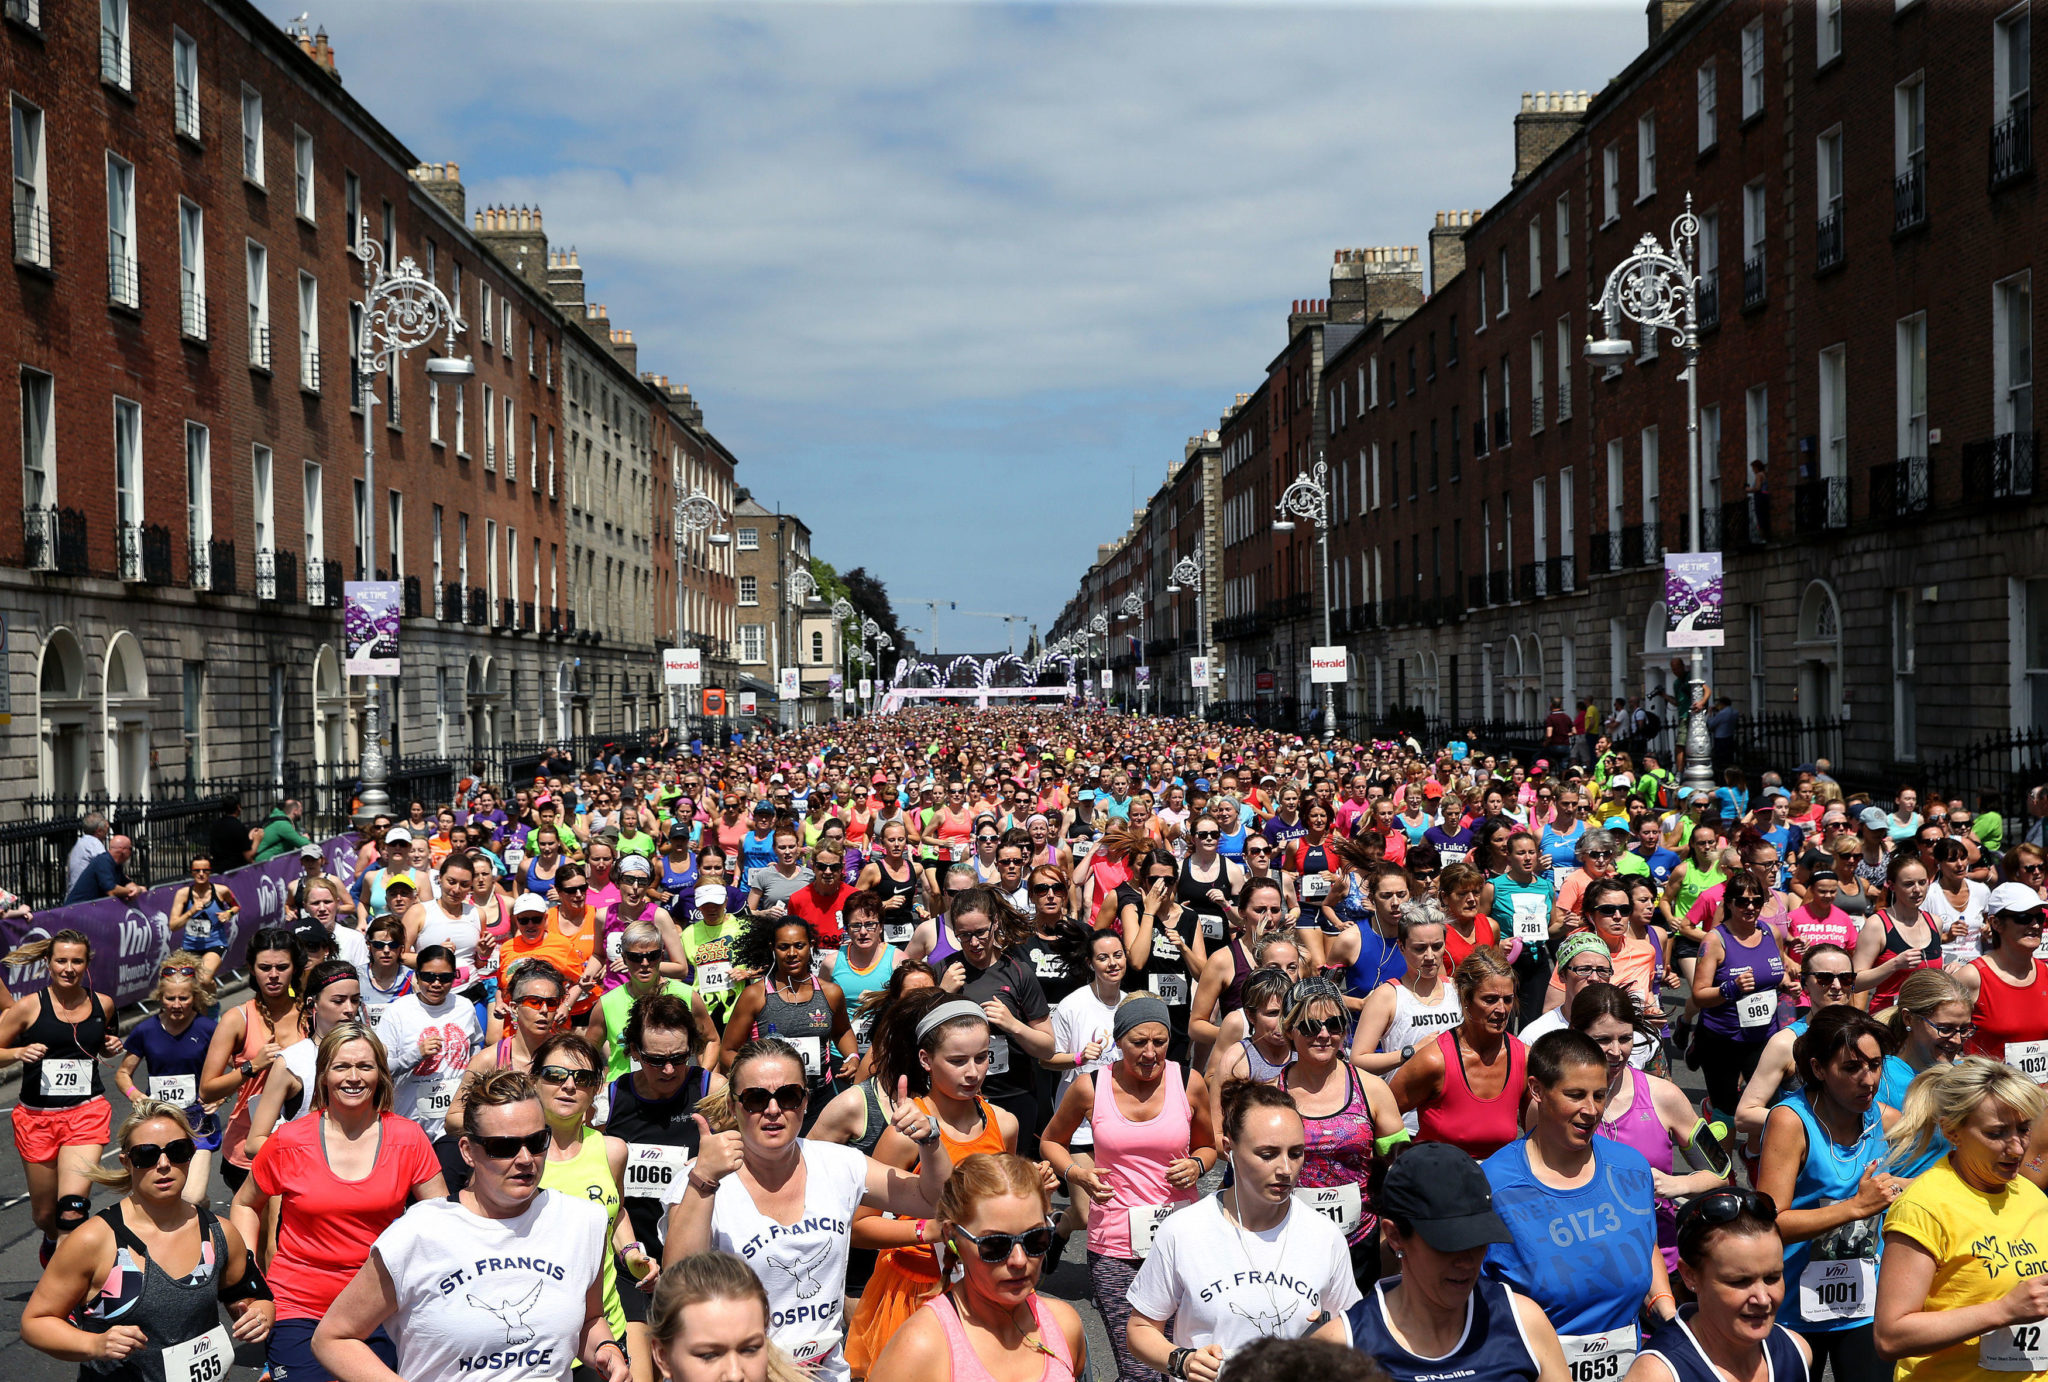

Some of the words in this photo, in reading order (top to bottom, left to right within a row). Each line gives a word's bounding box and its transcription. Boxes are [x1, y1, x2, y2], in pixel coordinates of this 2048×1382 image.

[1678, 562, 1690, 571] ME
[1691, 562, 1710, 571] TIME
[357, 591, 370, 600] ME
[371, 591, 388, 600] TIME
[666, 661, 699, 670] Herald
[1312, 658, 1345, 668] Herald
[1434, 842, 1441, 851] St
[1443, 842, 1468, 852] Luke's
[1311, 882, 1323, 890] 637
[256, 886, 277, 917] Vhi
[893, 925, 907, 936] 391
[1521, 923, 1540, 933] 2181
[1796, 923, 1824, 932] TEAM
[119, 918, 151, 957] Vhi
[697, 938, 726, 954] east
[695, 947, 730, 964] coast
[705, 973, 723, 985] 424
[1160, 985, 1178, 998] 878
[1748, 1003, 1769, 1018] 989
[1411, 1014, 1434, 1028] JUST
[1434, 1012, 1449, 1026] DO
[2026, 1046, 2039, 1054] Vhi
[2019, 1056, 2047, 1073] 1032
[55, 1073, 77, 1086] 279
[159, 1088, 184, 1102] 1542
[431, 1085, 445, 1093] Vhi
[430, 1094, 450, 1109] 798
[640, 1150, 660, 1160] Vhi
[627, 1165, 672, 1184] 1066
[1317, 1191, 1337, 1202] Vhi
[742, 1233, 769, 1260] ST.
[2007, 1239, 2038, 1258] Irish
[439, 1268, 472, 1295] ST.
[475, 1256, 566, 1281] FRANCIS
[1825, 1265, 1846, 1278] Vhi
[1200, 1279, 1229, 1303] ST.
[1234, 1271, 1320, 1307] FRANCIS
[1815, 1282, 1857, 1305] 1001
[771, 1300, 838, 1328] OSPICE
[1583, 1340, 1607, 1353] Vhi
[2012, 1326, 2040, 1352] 42
[193, 1340, 210, 1355] Vhi
[793, 1342, 817, 1358] Vhi
[458, 1348, 553, 1371] HOSPICE
[189, 1353, 221, 1382] 535
[1568, 1354, 1618, 1382] 1653
